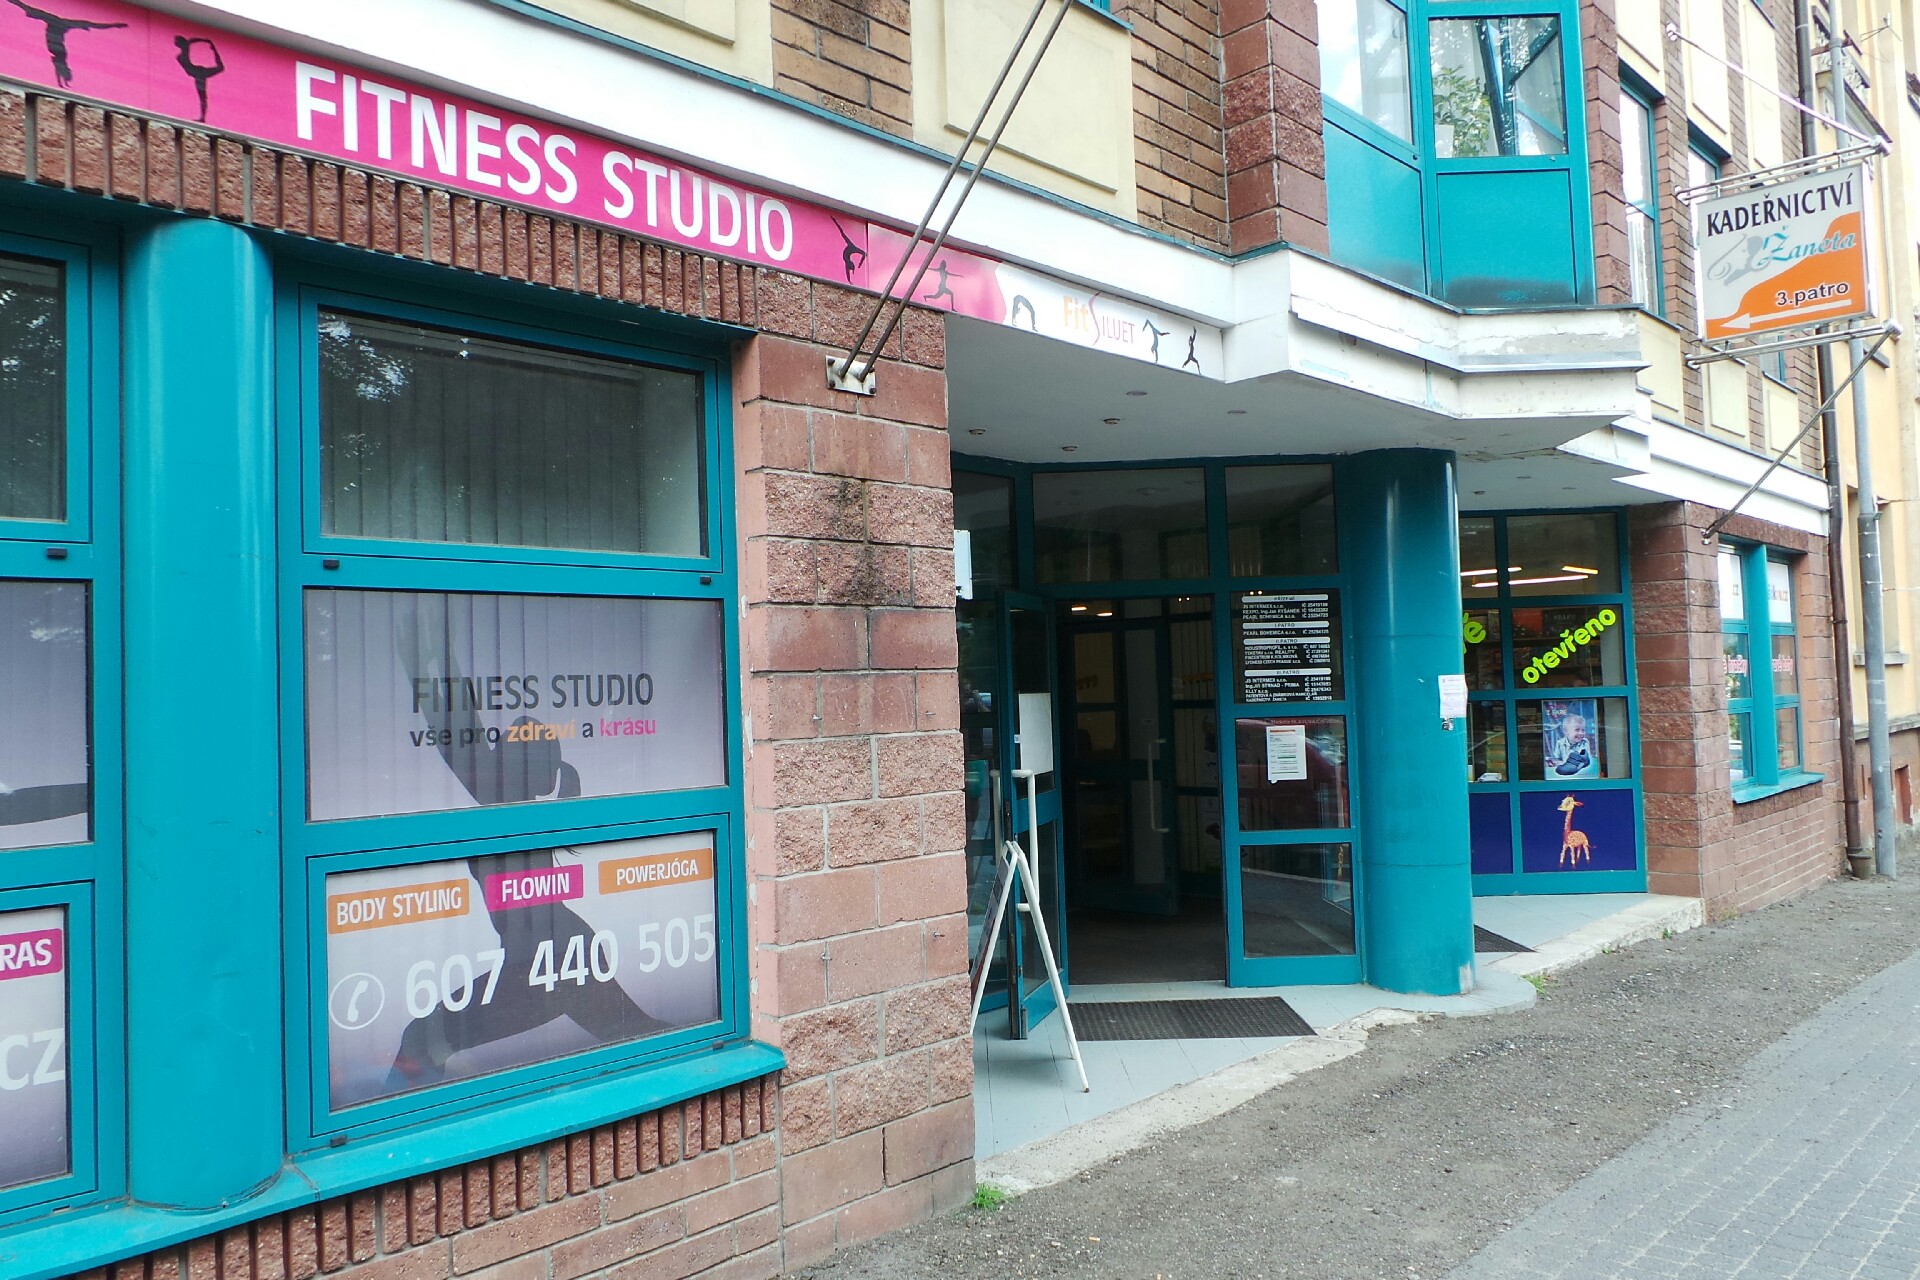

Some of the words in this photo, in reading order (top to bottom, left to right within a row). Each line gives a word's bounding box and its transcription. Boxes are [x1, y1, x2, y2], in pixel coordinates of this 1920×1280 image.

[296, 61, 578, 205] FITNESS
[602, 150, 793, 261] STUDIO
[1707, 172, 1853, 237] KADEŘNICTVÍ
[1757, 225, 1856, 262] Žaneta
[1776, 282, 1849, 306] 3.patro
[1523, 609, 1616, 684] otevřeno
[413, 675, 540, 713] FITNESS
[551, 673, 654, 709] STUDIO
[410, 725, 453, 747] vše
[459, 726, 501, 749] pro
[507, 719, 577, 743] zdraví
[582, 722, 594, 738] a
[600, 716, 657, 737] krásu
[501, 872, 570, 902] FLOWIN
[616, 857, 699, 886] POWERJÓGA
[337, 896, 386, 926] BODY
[392, 886, 462, 918] STYLING
[405, 948, 505, 1019] 607
[529, 930, 619, 992] 440
[638, 913, 716, 973] 505
